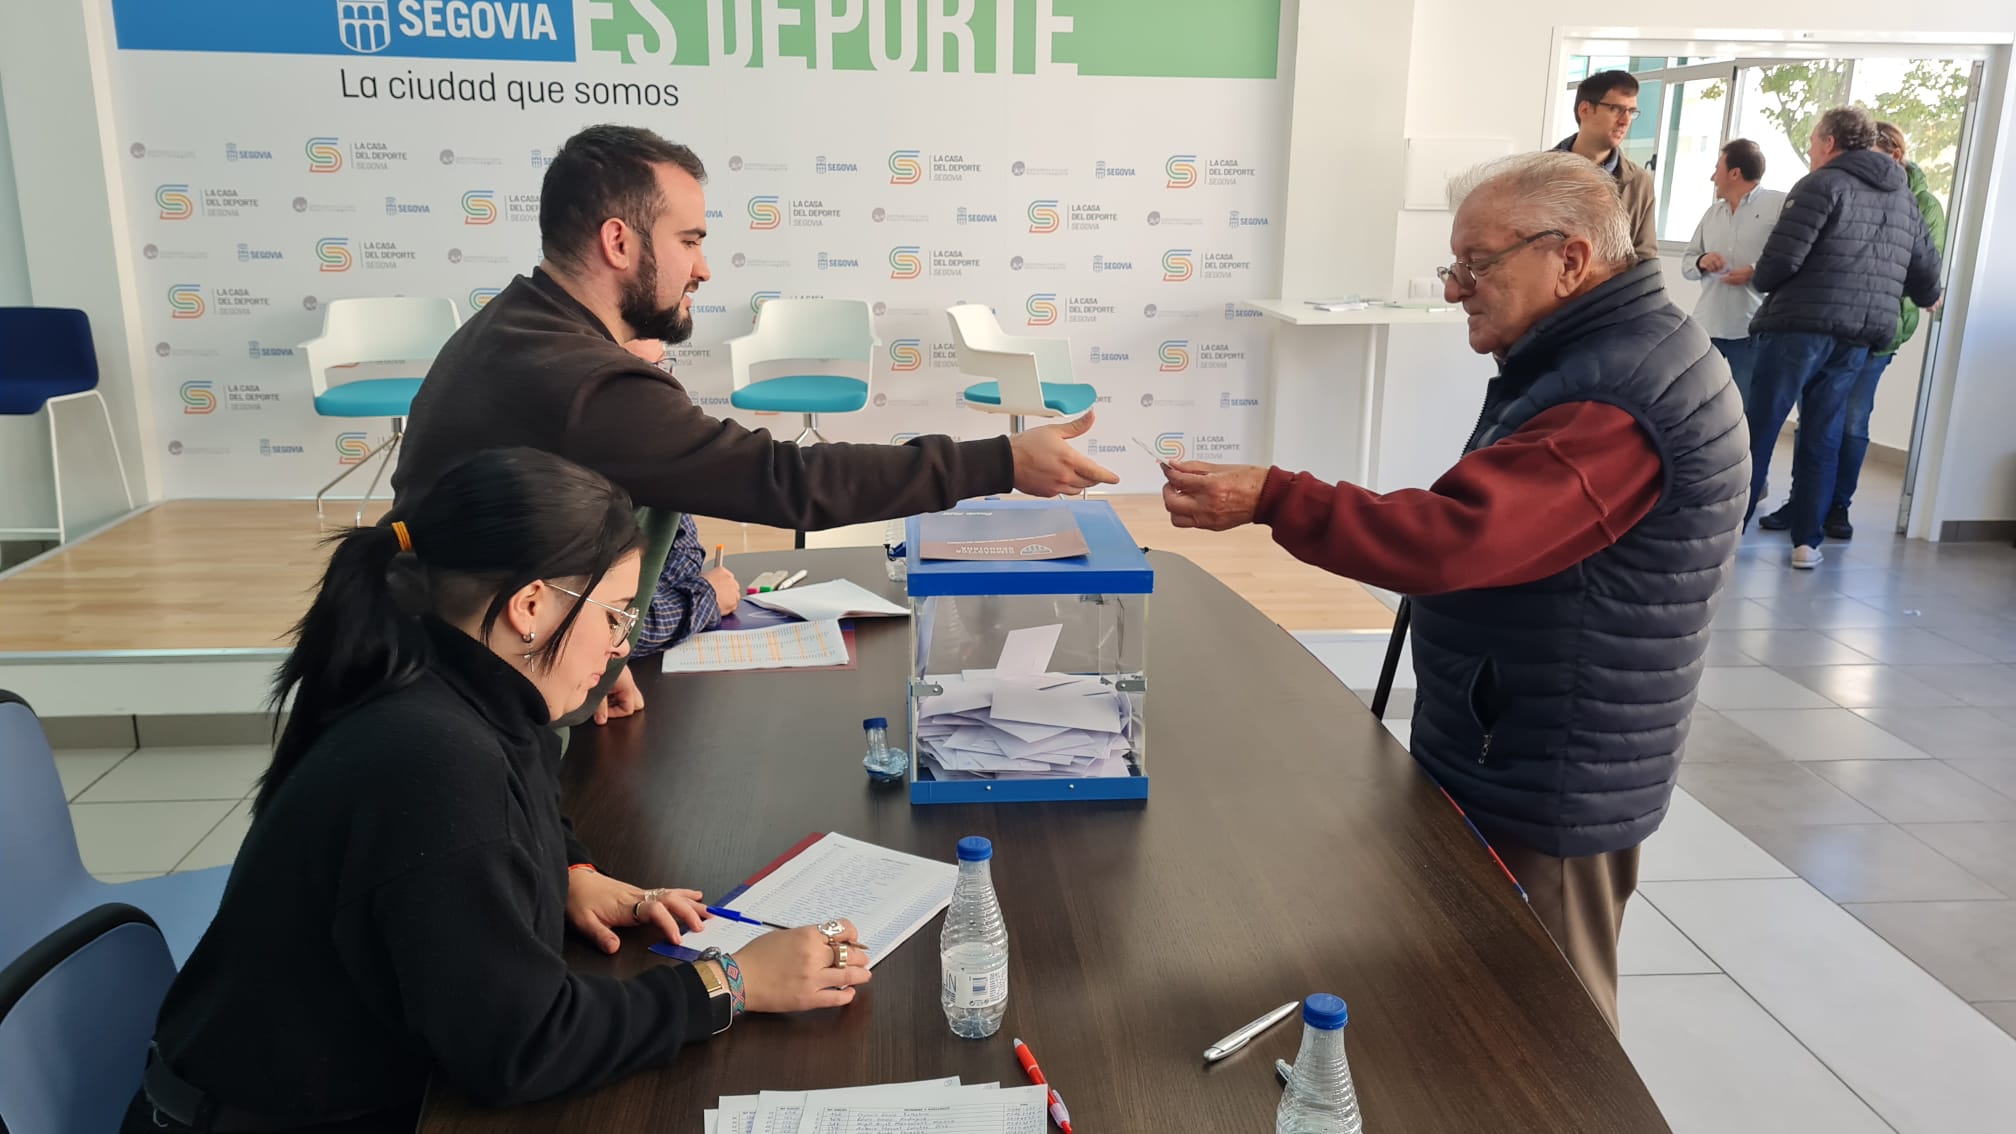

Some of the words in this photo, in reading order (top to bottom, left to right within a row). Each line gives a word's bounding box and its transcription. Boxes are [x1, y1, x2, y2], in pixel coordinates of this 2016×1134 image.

[398, 0, 558, 41] SEGOVIA
[574, 0, 677, 66] ES
[707, 0, 1078, 75] DEPORTE
[340, 68, 378, 99] La
[389, 70, 496, 102] ciudad
[507, 79, 565, 110] que
[574, 81, 679, 107] somos
[366, 143, 388, 151] CASA
[239, 151, 272, 159] SEGOVIA
[355, 152, 370, 160] DEL
[372, 152, 407, 160] DEPORTE
[828, 163, 857, 171] SEGOVIA
[949, 164, 981, 172] DEPORTE
[1107, 168, 1135, 176] SEGOVIA
[509, 195, 519, 203] LA
[398, 205, 430, 213] SEGOVIA
[510, 203, 524, 212] DEL
[705, 210, 723, 218] OVIA
[793, 209, 807, 217] DEL
[1086, 213, 1117, 221] DEPORTE
[510, 214, 538, 222] SEGOVI
[968, 214, 997, 222] SEGOVIA
[364, 242, 375, 250] LA
[250, 251, 283, 259] SEGOVIA
[365, 251, 380, 259] DEL
[949, 259, 980, 267] DEPORTE
[1104, 262, 1132, 270] SEGOVIA
[696, 305, 726, 313] SEGOVIA
[261, 348, 293, 356] SEGOVIA
